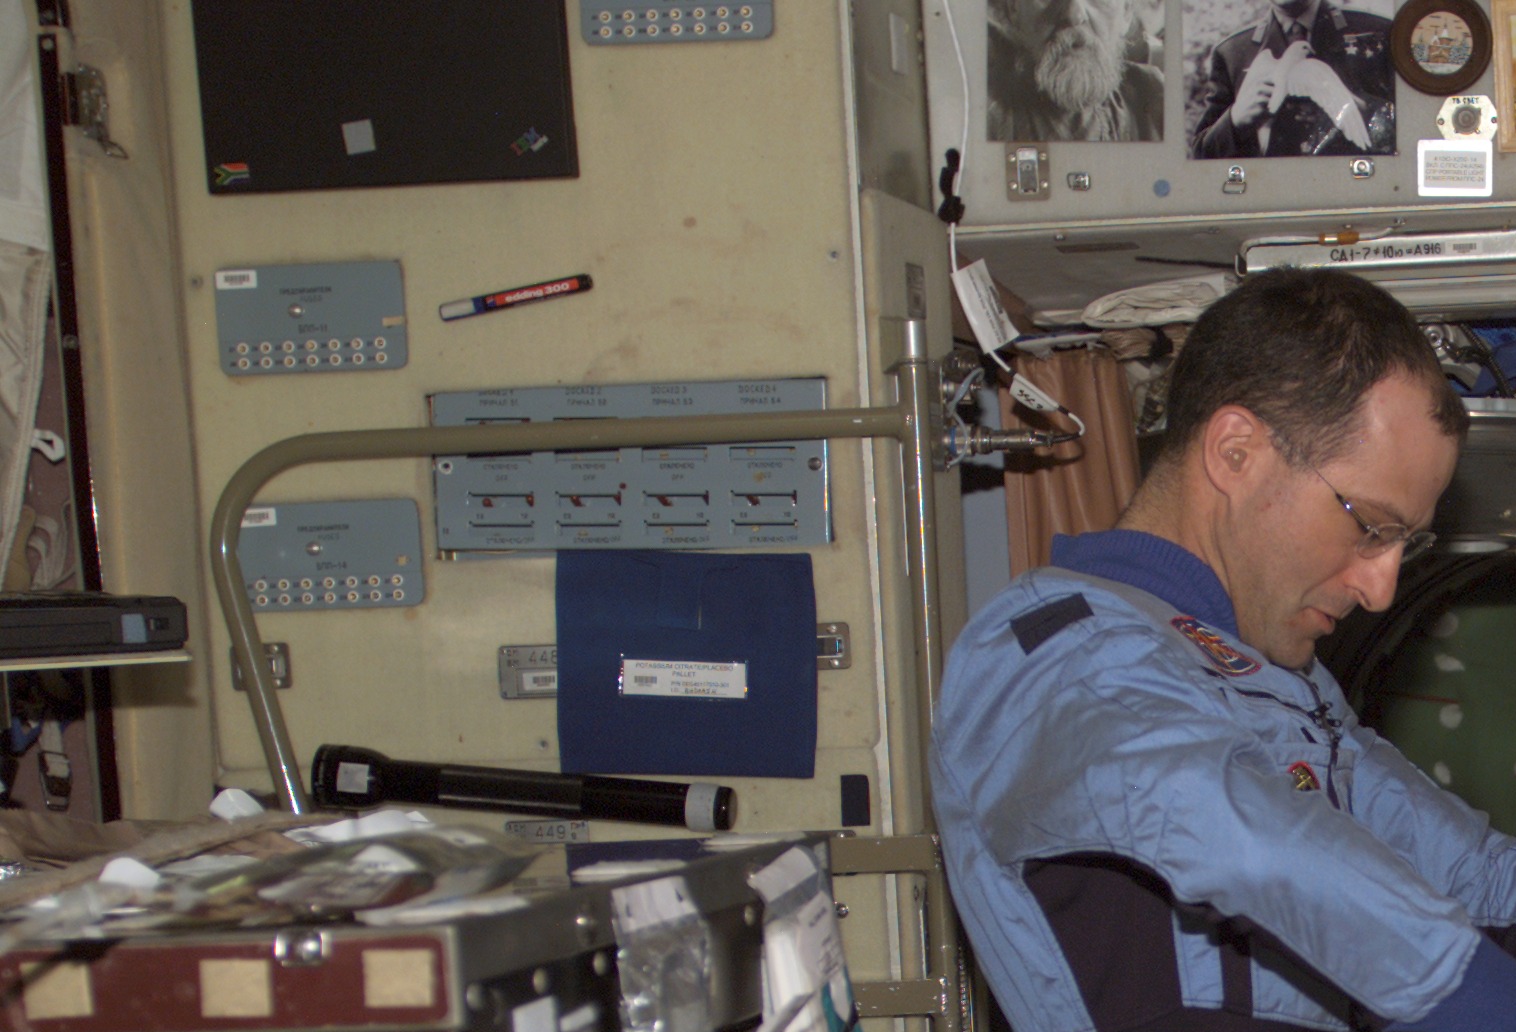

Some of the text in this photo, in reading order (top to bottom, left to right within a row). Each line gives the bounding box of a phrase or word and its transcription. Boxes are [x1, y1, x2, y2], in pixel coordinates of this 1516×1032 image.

[505, 283, 569, 302] edding 300
[651, 386, 681, 394] DOCKED
[738, 385, 771, 393] DOCKED
[536, 825, 565, 839] 449
